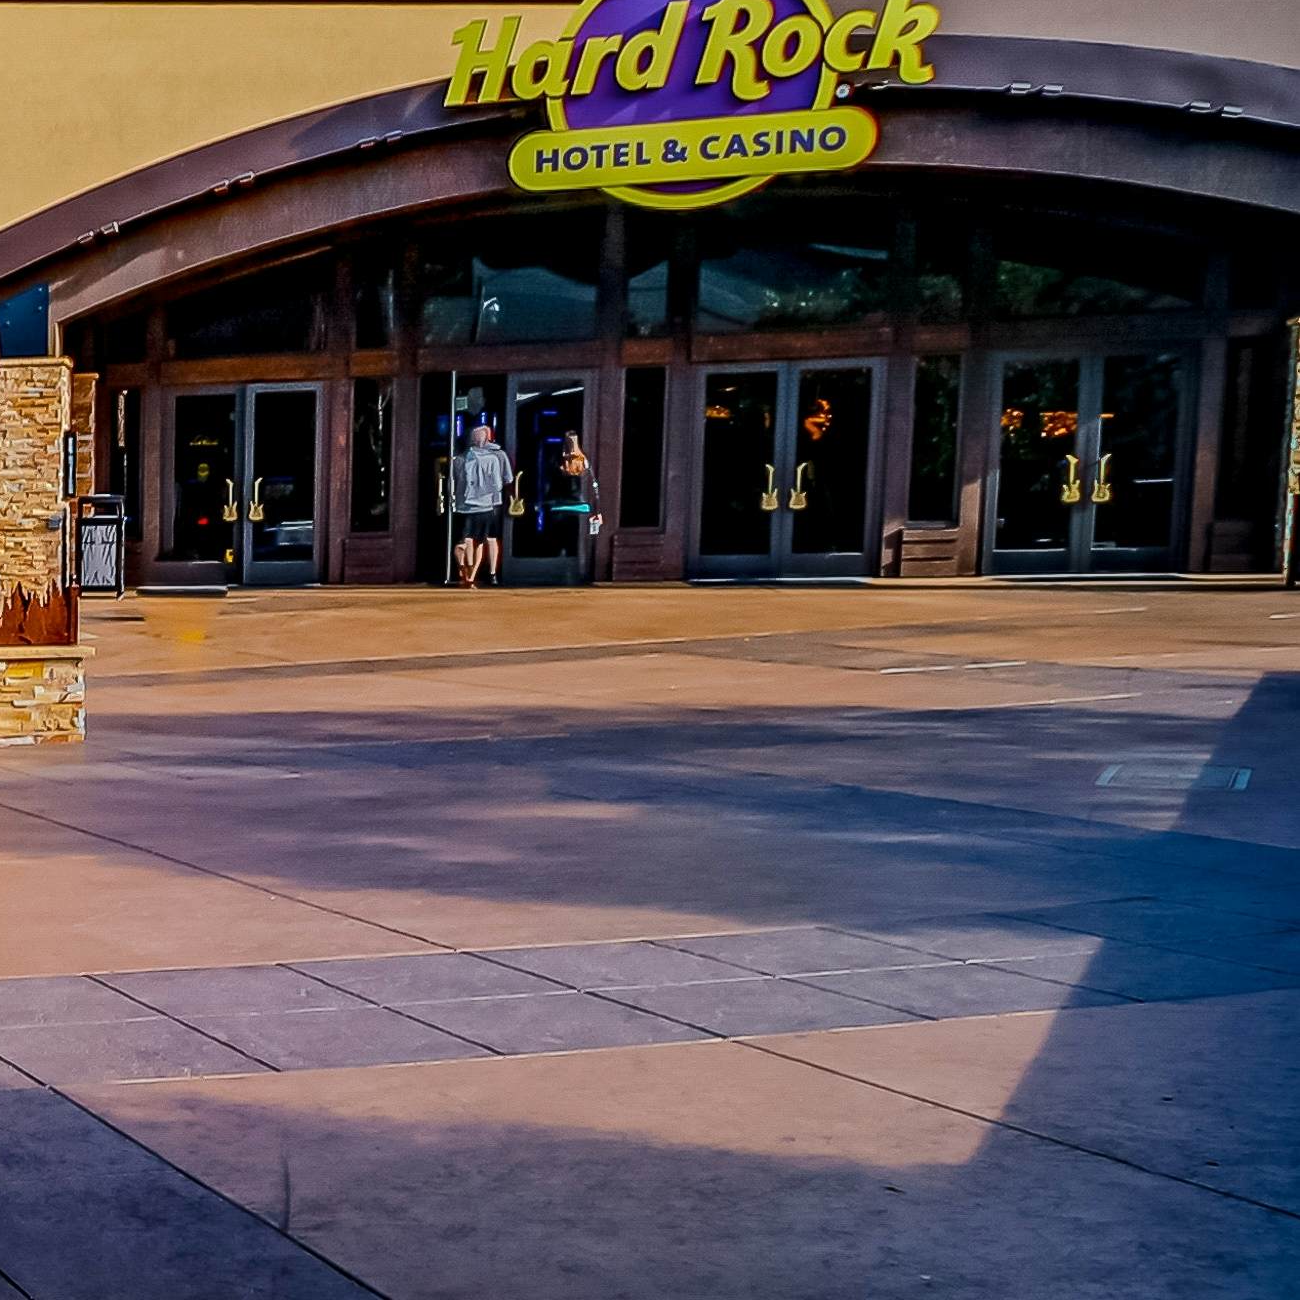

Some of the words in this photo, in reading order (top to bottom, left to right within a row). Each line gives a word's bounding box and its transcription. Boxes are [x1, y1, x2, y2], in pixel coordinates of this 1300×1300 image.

[535, 141, 651, 174] HOTEL
[660, 138, 689, 164] &
[699, 126, 848, 160] CASINO
